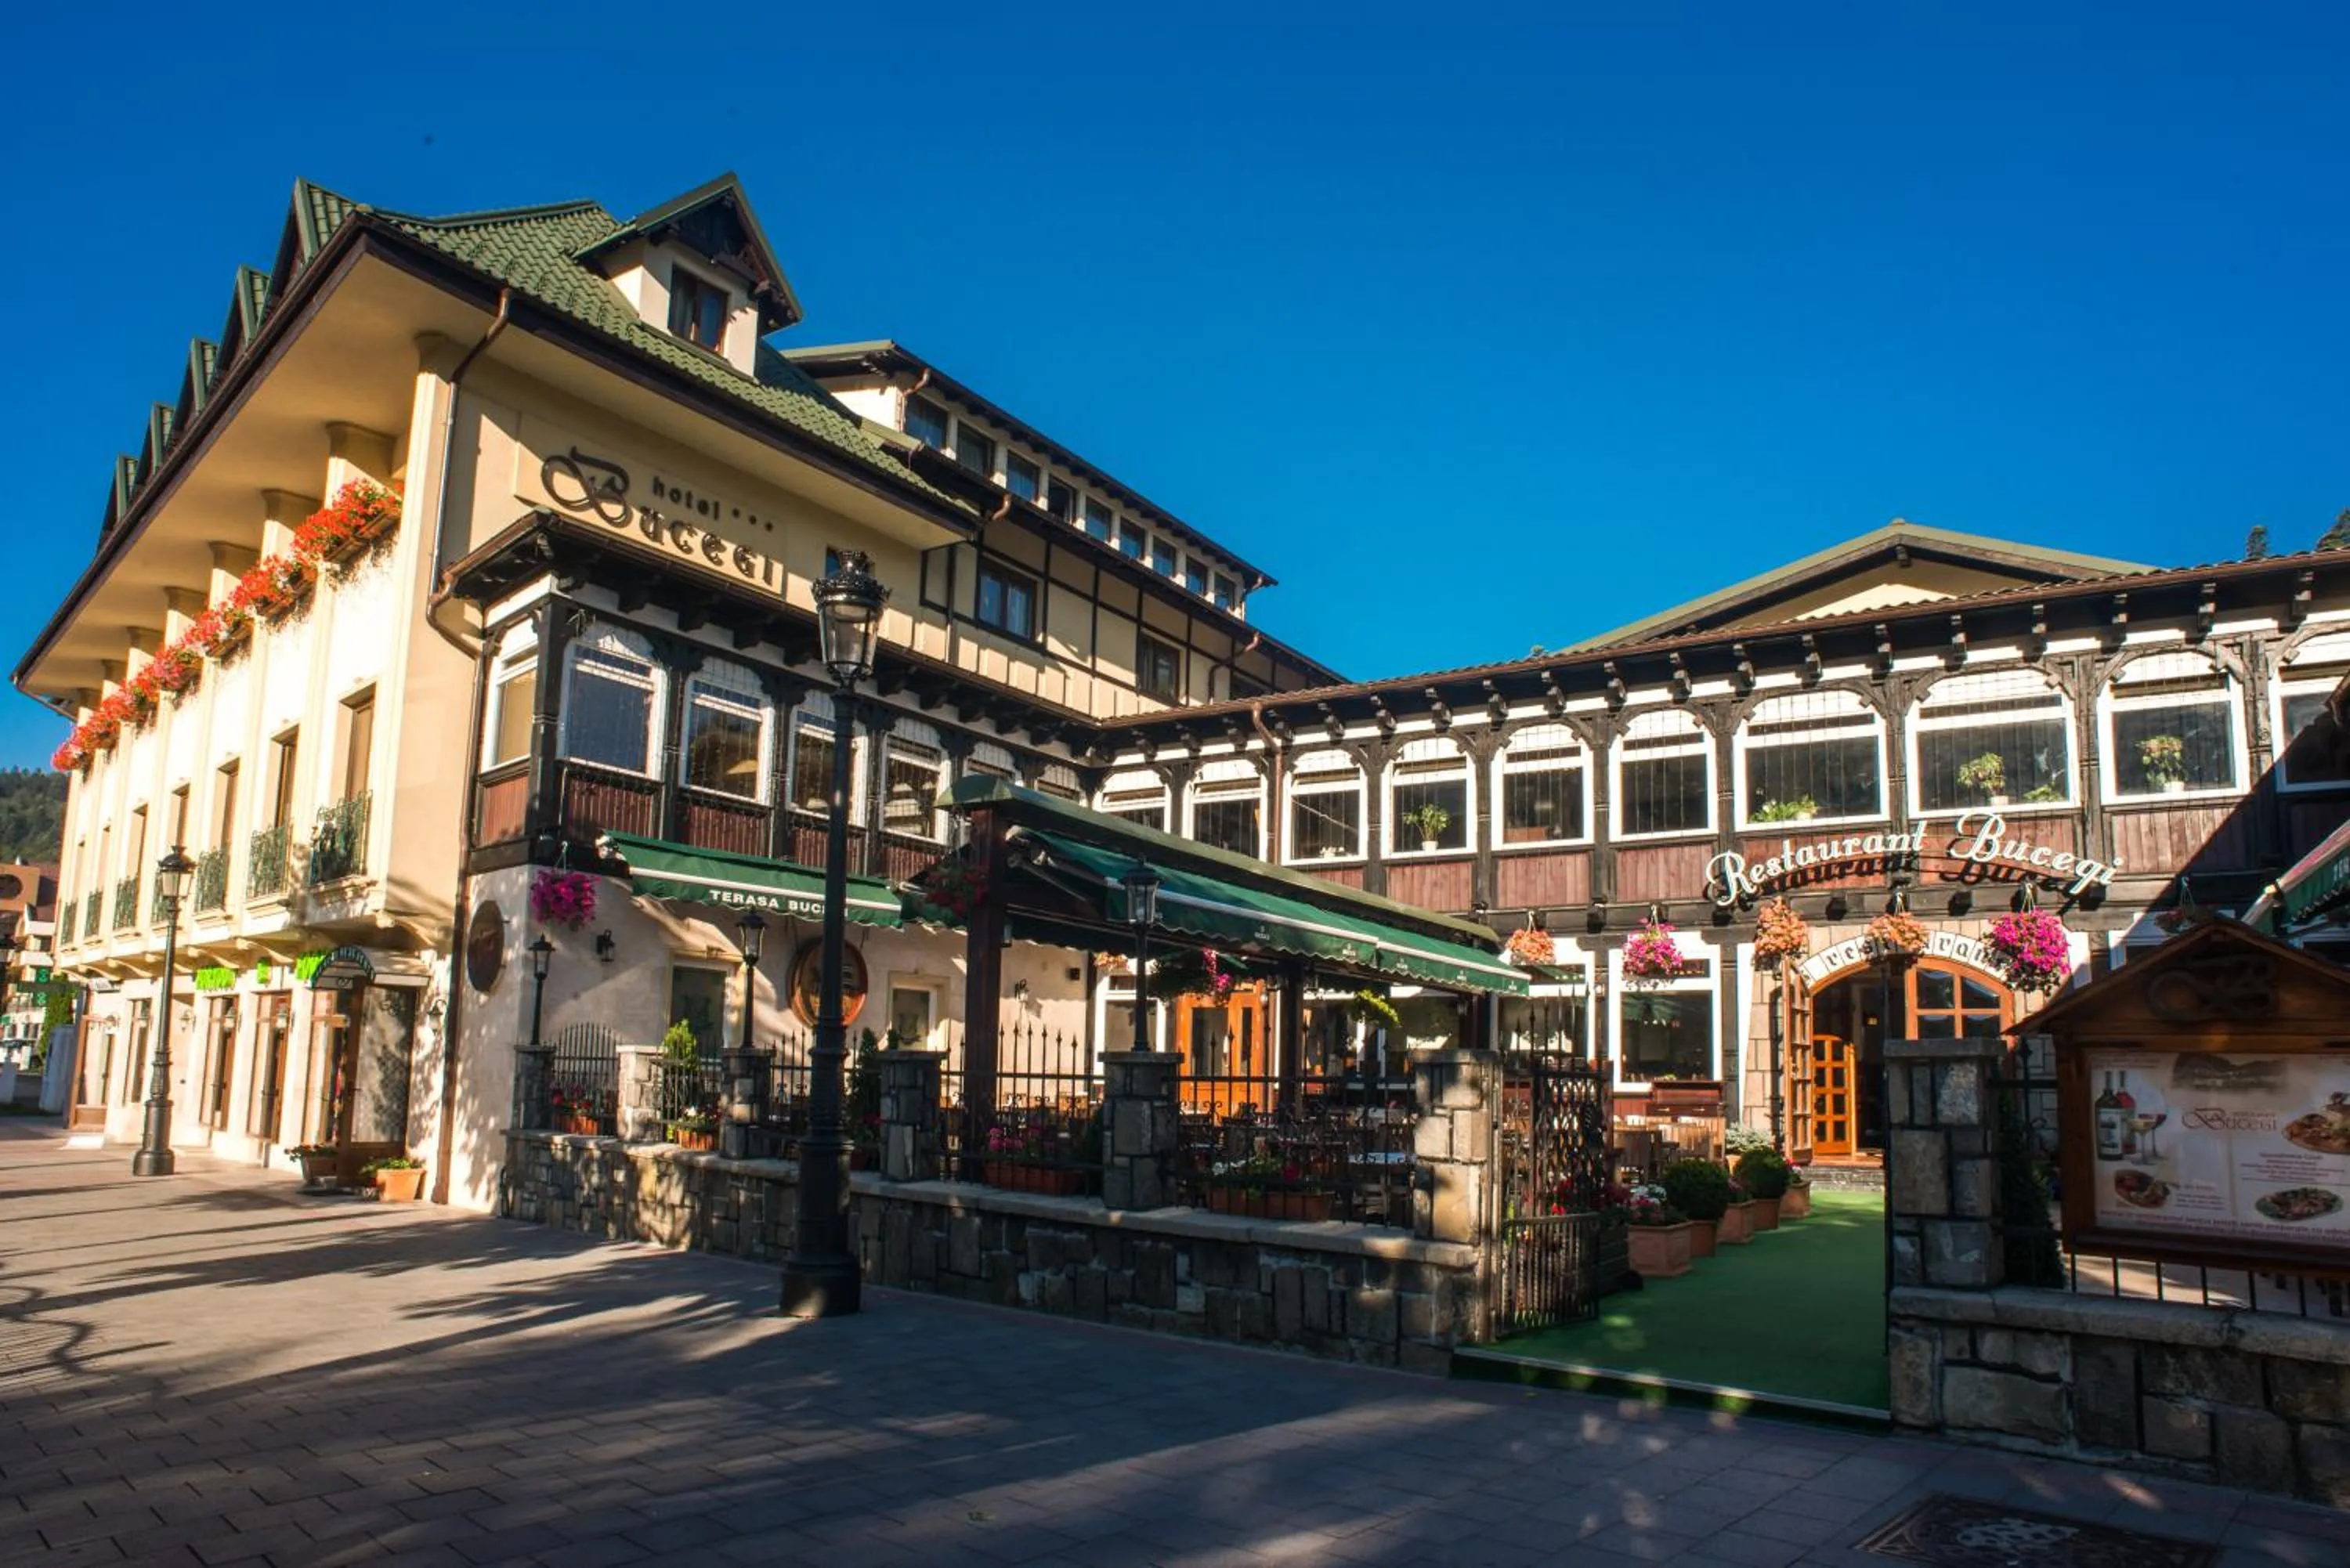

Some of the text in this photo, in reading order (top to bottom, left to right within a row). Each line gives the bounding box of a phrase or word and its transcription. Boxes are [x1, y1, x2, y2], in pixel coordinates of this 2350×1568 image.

[652, 475, 721, 521] hotel
[1705, 811, 2124, 907] Restaurant Bucegi
[709, 889, 849, 917] TERASA BUCI
